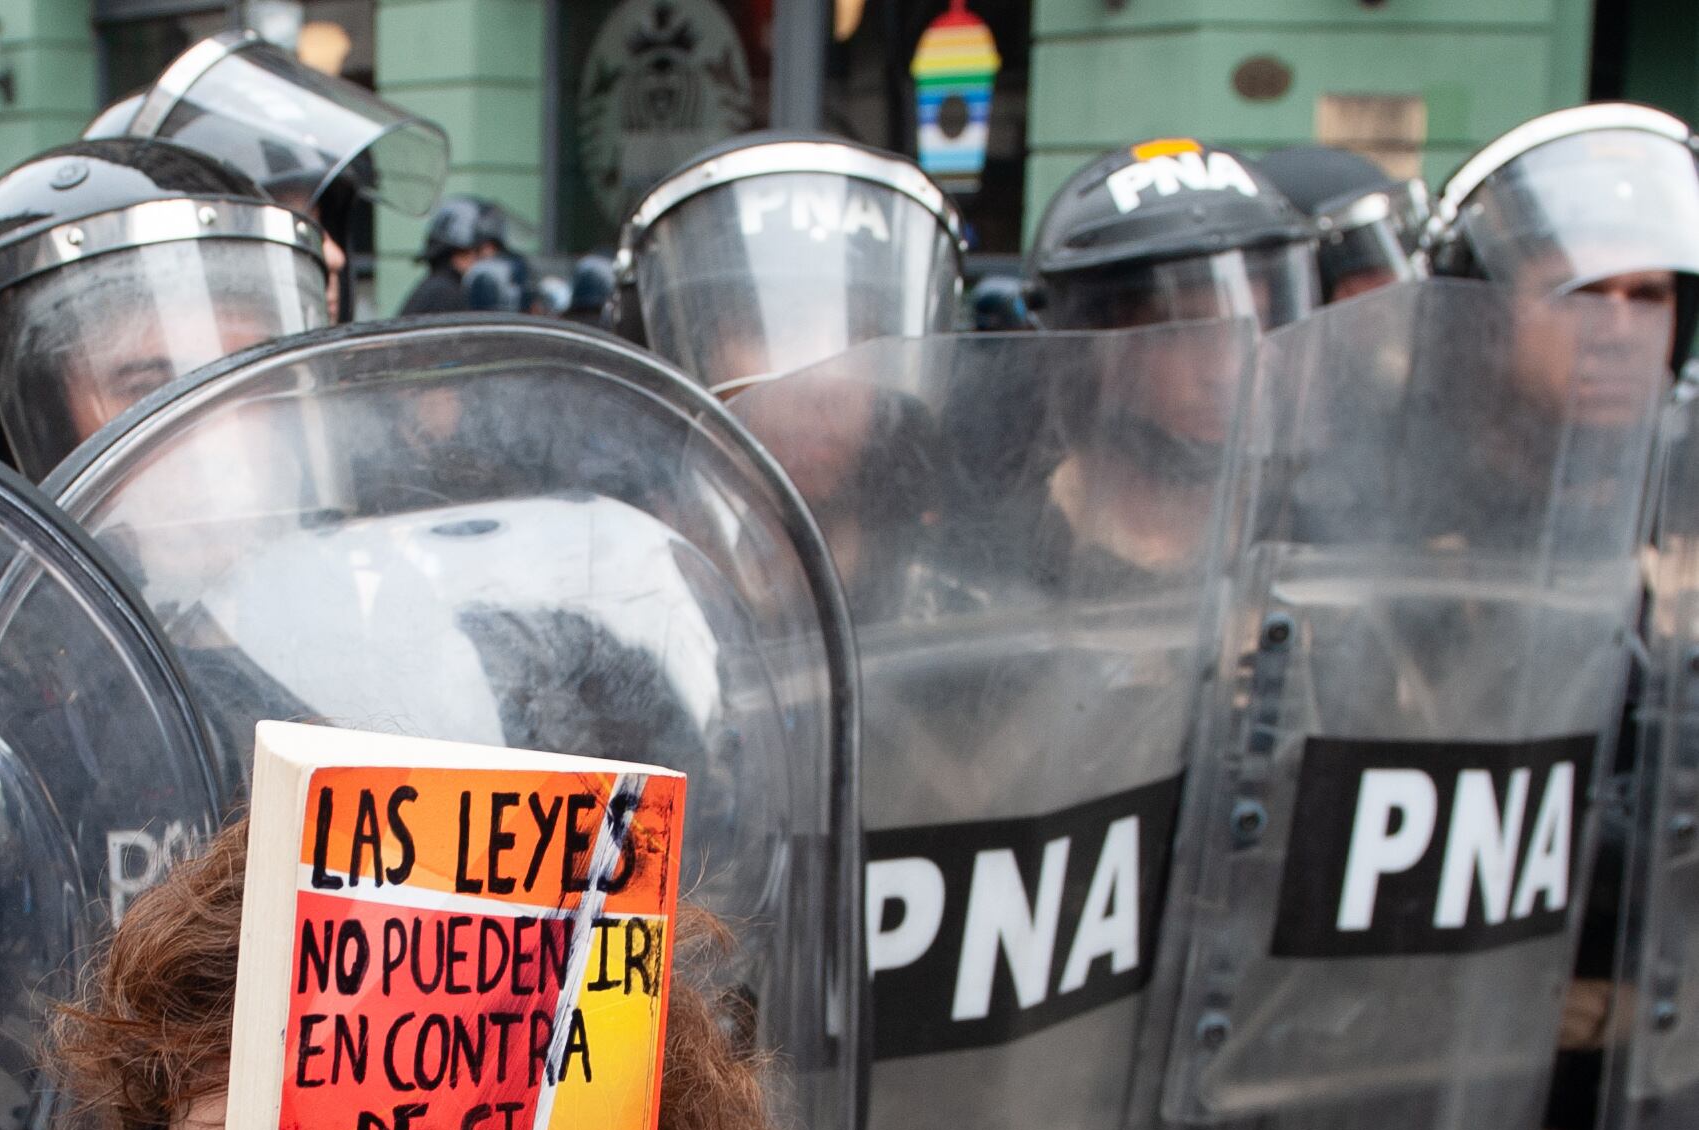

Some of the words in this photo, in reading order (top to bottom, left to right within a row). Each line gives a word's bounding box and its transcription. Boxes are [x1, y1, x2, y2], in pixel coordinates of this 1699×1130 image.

[740, 184, 890, 243] PNA
[1105, 150, 1259, 215] PNA
[311, 785, 419, 891] LAS
[455, 790, 639, 895] LEYES
[1336, 760, 1576, 932] PNA
[297, 917, 370, 995] NO
[382, 916, 575, 995] PUEDEN
[587, 917, 652, 996] IR
[864, 817, 1141, 1022] PNA
[296, 1013, 369, 1087] EN
[383, 1008, 591, 1091] CONTRA
